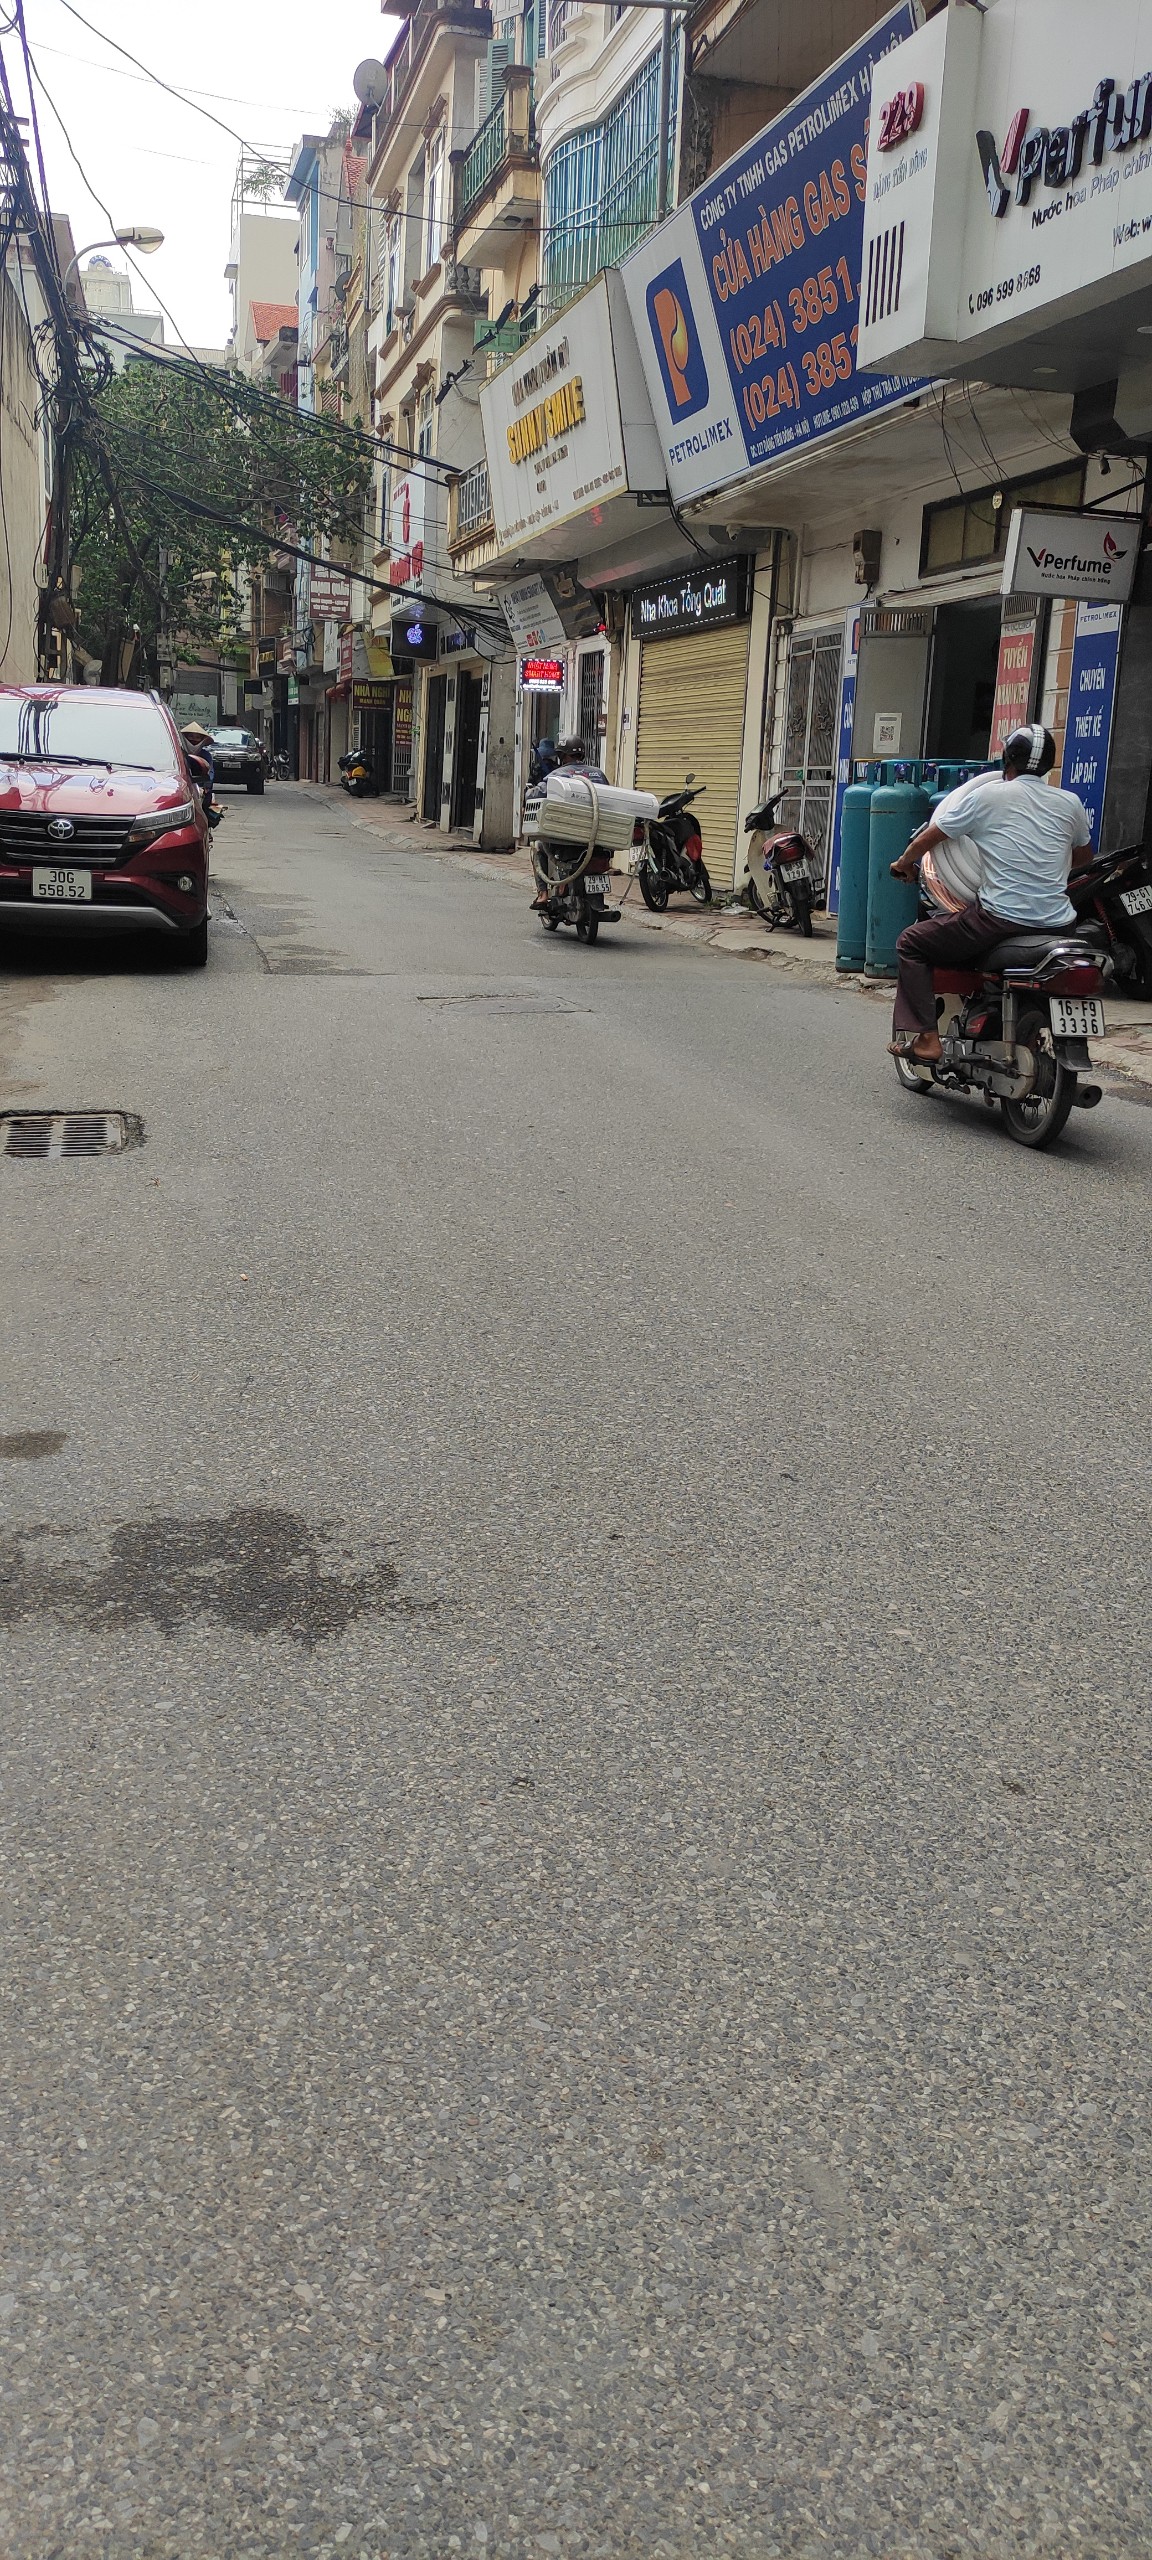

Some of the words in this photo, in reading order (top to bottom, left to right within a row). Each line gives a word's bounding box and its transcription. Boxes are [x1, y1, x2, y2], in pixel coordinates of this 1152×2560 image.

[877, 82, 925, 152] 229
[700, 195, 726, 231] CÔNG
[724, 182, 738, 210] TY
[736, 159, 766, 199] TNHH
[764, 143, 789, 176] GAS
[787, 78, 860, 158] PETROLIMEX
[1032, 200, 1063, 229] Nước
[1065, 187, 1087, 211] hoa
[1090, 167, 1120, 198] Pháp
[712, 228, 752, 303] CỬA
[747, 196, 805, 278] HÀNG
[803, 159, 851, 236] GAS
[1113, 218, 1141, 247] Web:
[976, 290, 994, 311] 096
[996, 278, 1014, 302] 599
[1016, 264, 1042, 293] 8668
[729, 300, 787, 374] (024)
[742, 362, 800, 431] (024)
[507, 403, 548, 465] SUNNY
[544, 375, 586, 439] SMILE
[668, 417, 733, 466] PETROLIMEX
[1027, 546, 1111, 574] VPerfume
[640, 599, 656, 623] Nha
[658, 595, 678, 619] Khoa
[680, 582, 701, 617] Tổng
[704, 578, 726, 608] Quát
[1080, 610, 1117, 622] PETROLIMEX
[1003, 638, 1028, 670] TUYỂN
[354, 684, 370, 697] NHÀ
[1079, 662, 1106, 692] CHUYÊN
[1075, 706, 1094, 738] THIẾT
[1093, 705, 1104, 737] KẾ
[1070, 748, 1083, 784] LẮP
[1082, 755, 1098, 790] ĐẶT
[38, 883, 85, 898] 558.52
[49, 871, 75, 883] 30G
[1125, 887, 1150, 904] 29-G1
[1058, 999, 1097, 1017] 16-F9
[1059, 1018, 1099, 1035] 3336
